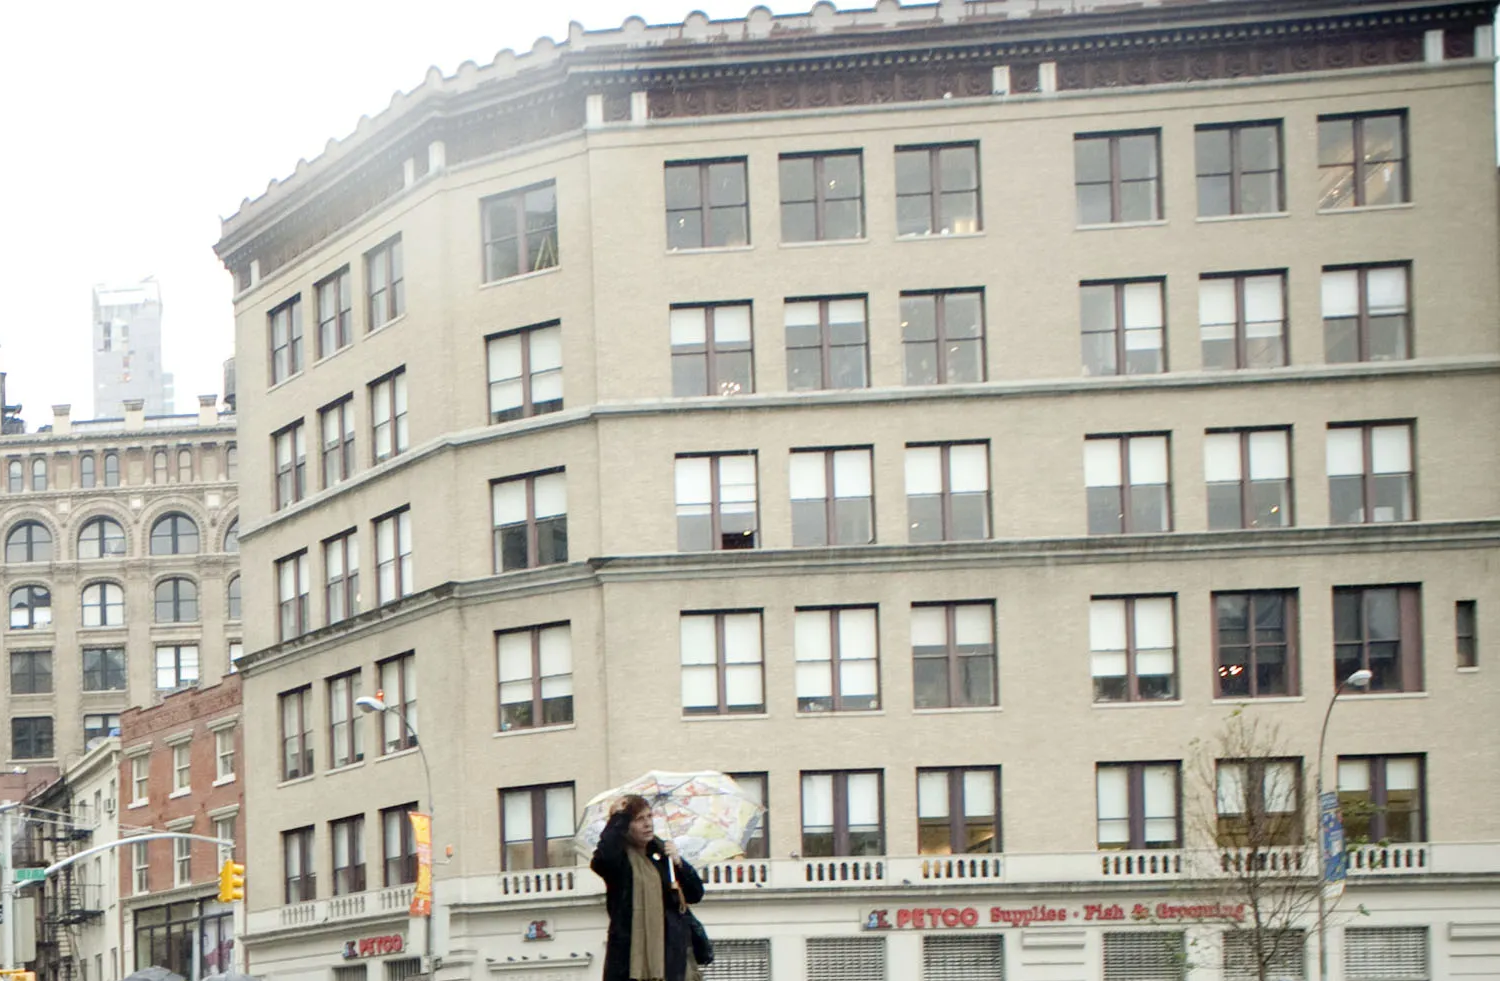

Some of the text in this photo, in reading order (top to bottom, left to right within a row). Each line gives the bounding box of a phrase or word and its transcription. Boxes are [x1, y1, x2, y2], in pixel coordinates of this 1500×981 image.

[897, 908, 979, 928] PETCO
[990, 906, 1067, 927] Supplies
[1084, 904, 1125, 920] Fish
[359, 934, 403, 956] PETCO
